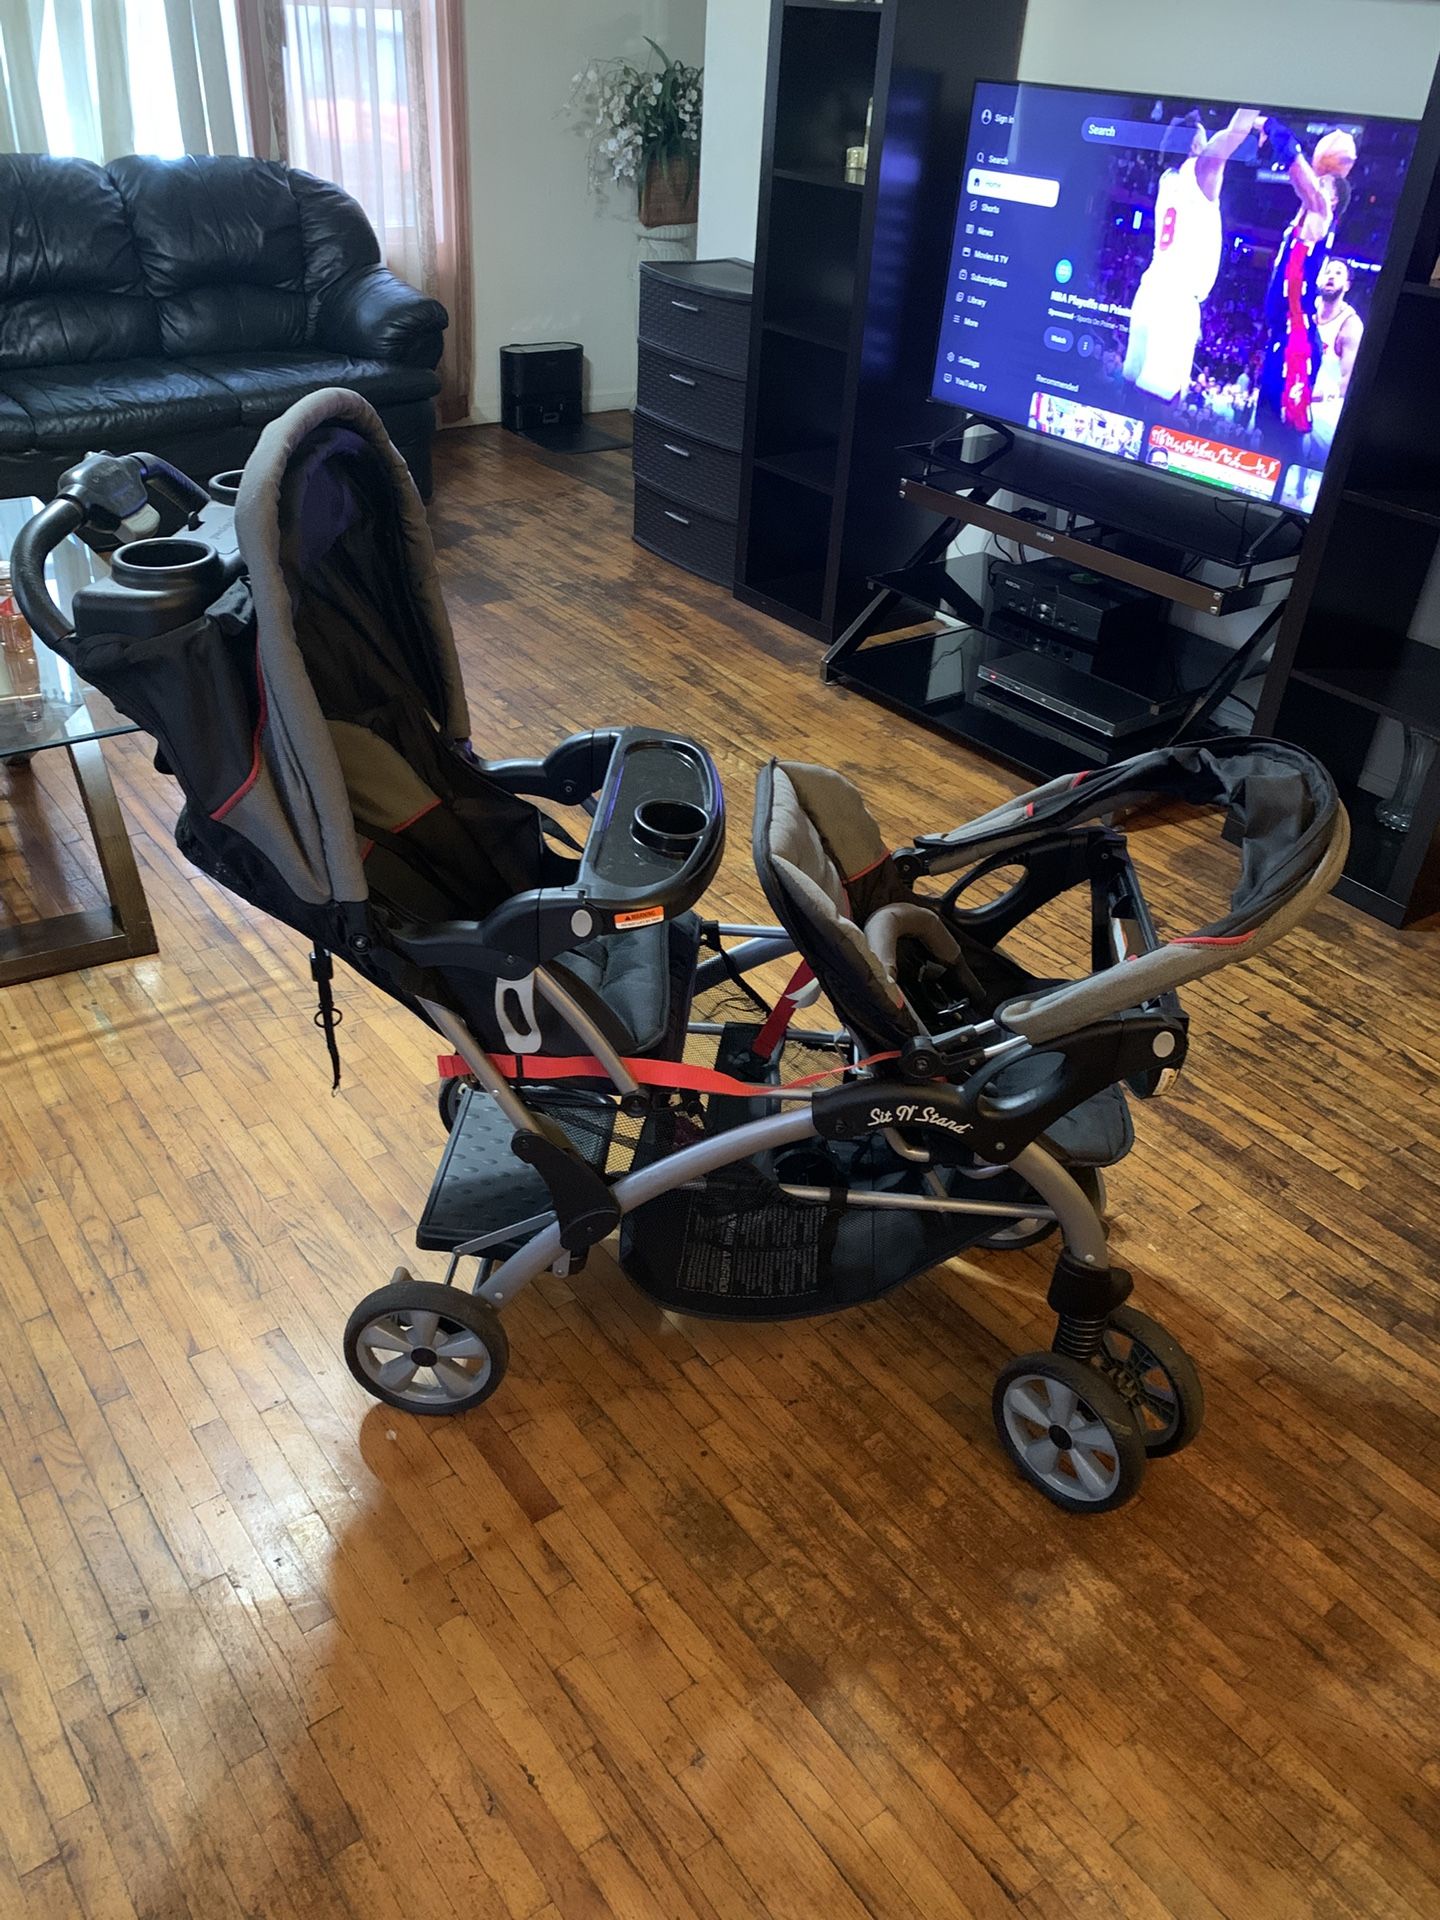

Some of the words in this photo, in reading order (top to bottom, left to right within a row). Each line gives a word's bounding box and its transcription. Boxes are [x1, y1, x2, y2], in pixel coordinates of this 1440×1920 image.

[994, 114, 1008, 125] Sign
[1088, 124, 1116, 137] Search
[988, 155, 1009, 166] Search
[981, 203, 1000, 214] Shorts
[977, 227, 994, 237] News
[974, 250, 994, 261] Movies
[994, 254, 999, 262] &
[1000, 255, 1009, 264] TV
[971, 273, 1008, 288] Subscriptions
[967, 296, 987, 308] Library
[1050, 291, 1067, 303] NBA
[1068, 294, 1098, 310] Playoffs
[1098, 303, 1109, 312] on
[964, 317, 979, 327] More
[958, 356, 980, 369] Settings
[955, 377, 978, 390] YouTube
[978, 384, 987, 392] TV
[1036, 374, 1079, 392] Recommended
[867, 1108, 893, 1126] Sit
[915, 1107, 971, 1134] Stand
